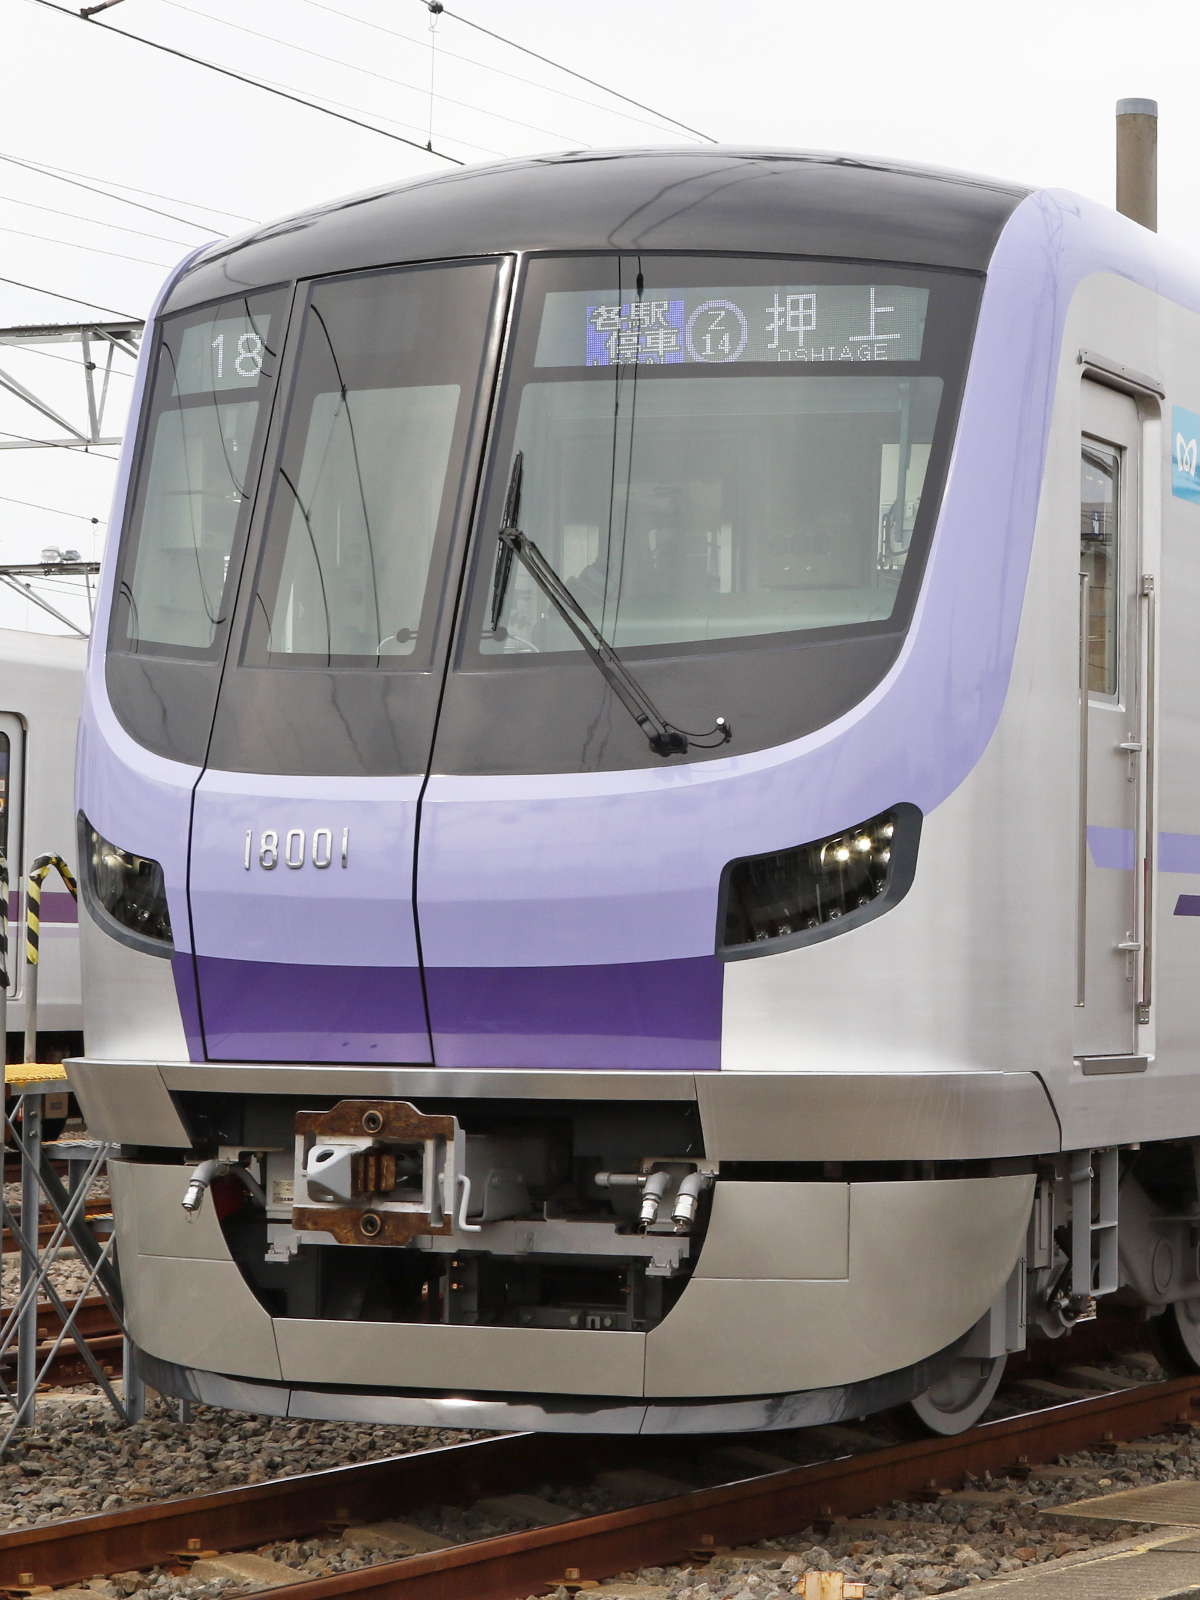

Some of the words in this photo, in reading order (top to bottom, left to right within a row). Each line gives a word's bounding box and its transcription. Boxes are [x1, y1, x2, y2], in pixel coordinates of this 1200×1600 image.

[590, 300, 668, 331] 各駅
[708, 310, 725, 330] Z
[765, 287, 901, 348] 押上
[210, 333, 263, 378] 18
[606, 328, 680, 358] 停車
[701, 332, 732, 355] 14
[243, 827, 350, 872] 18001
